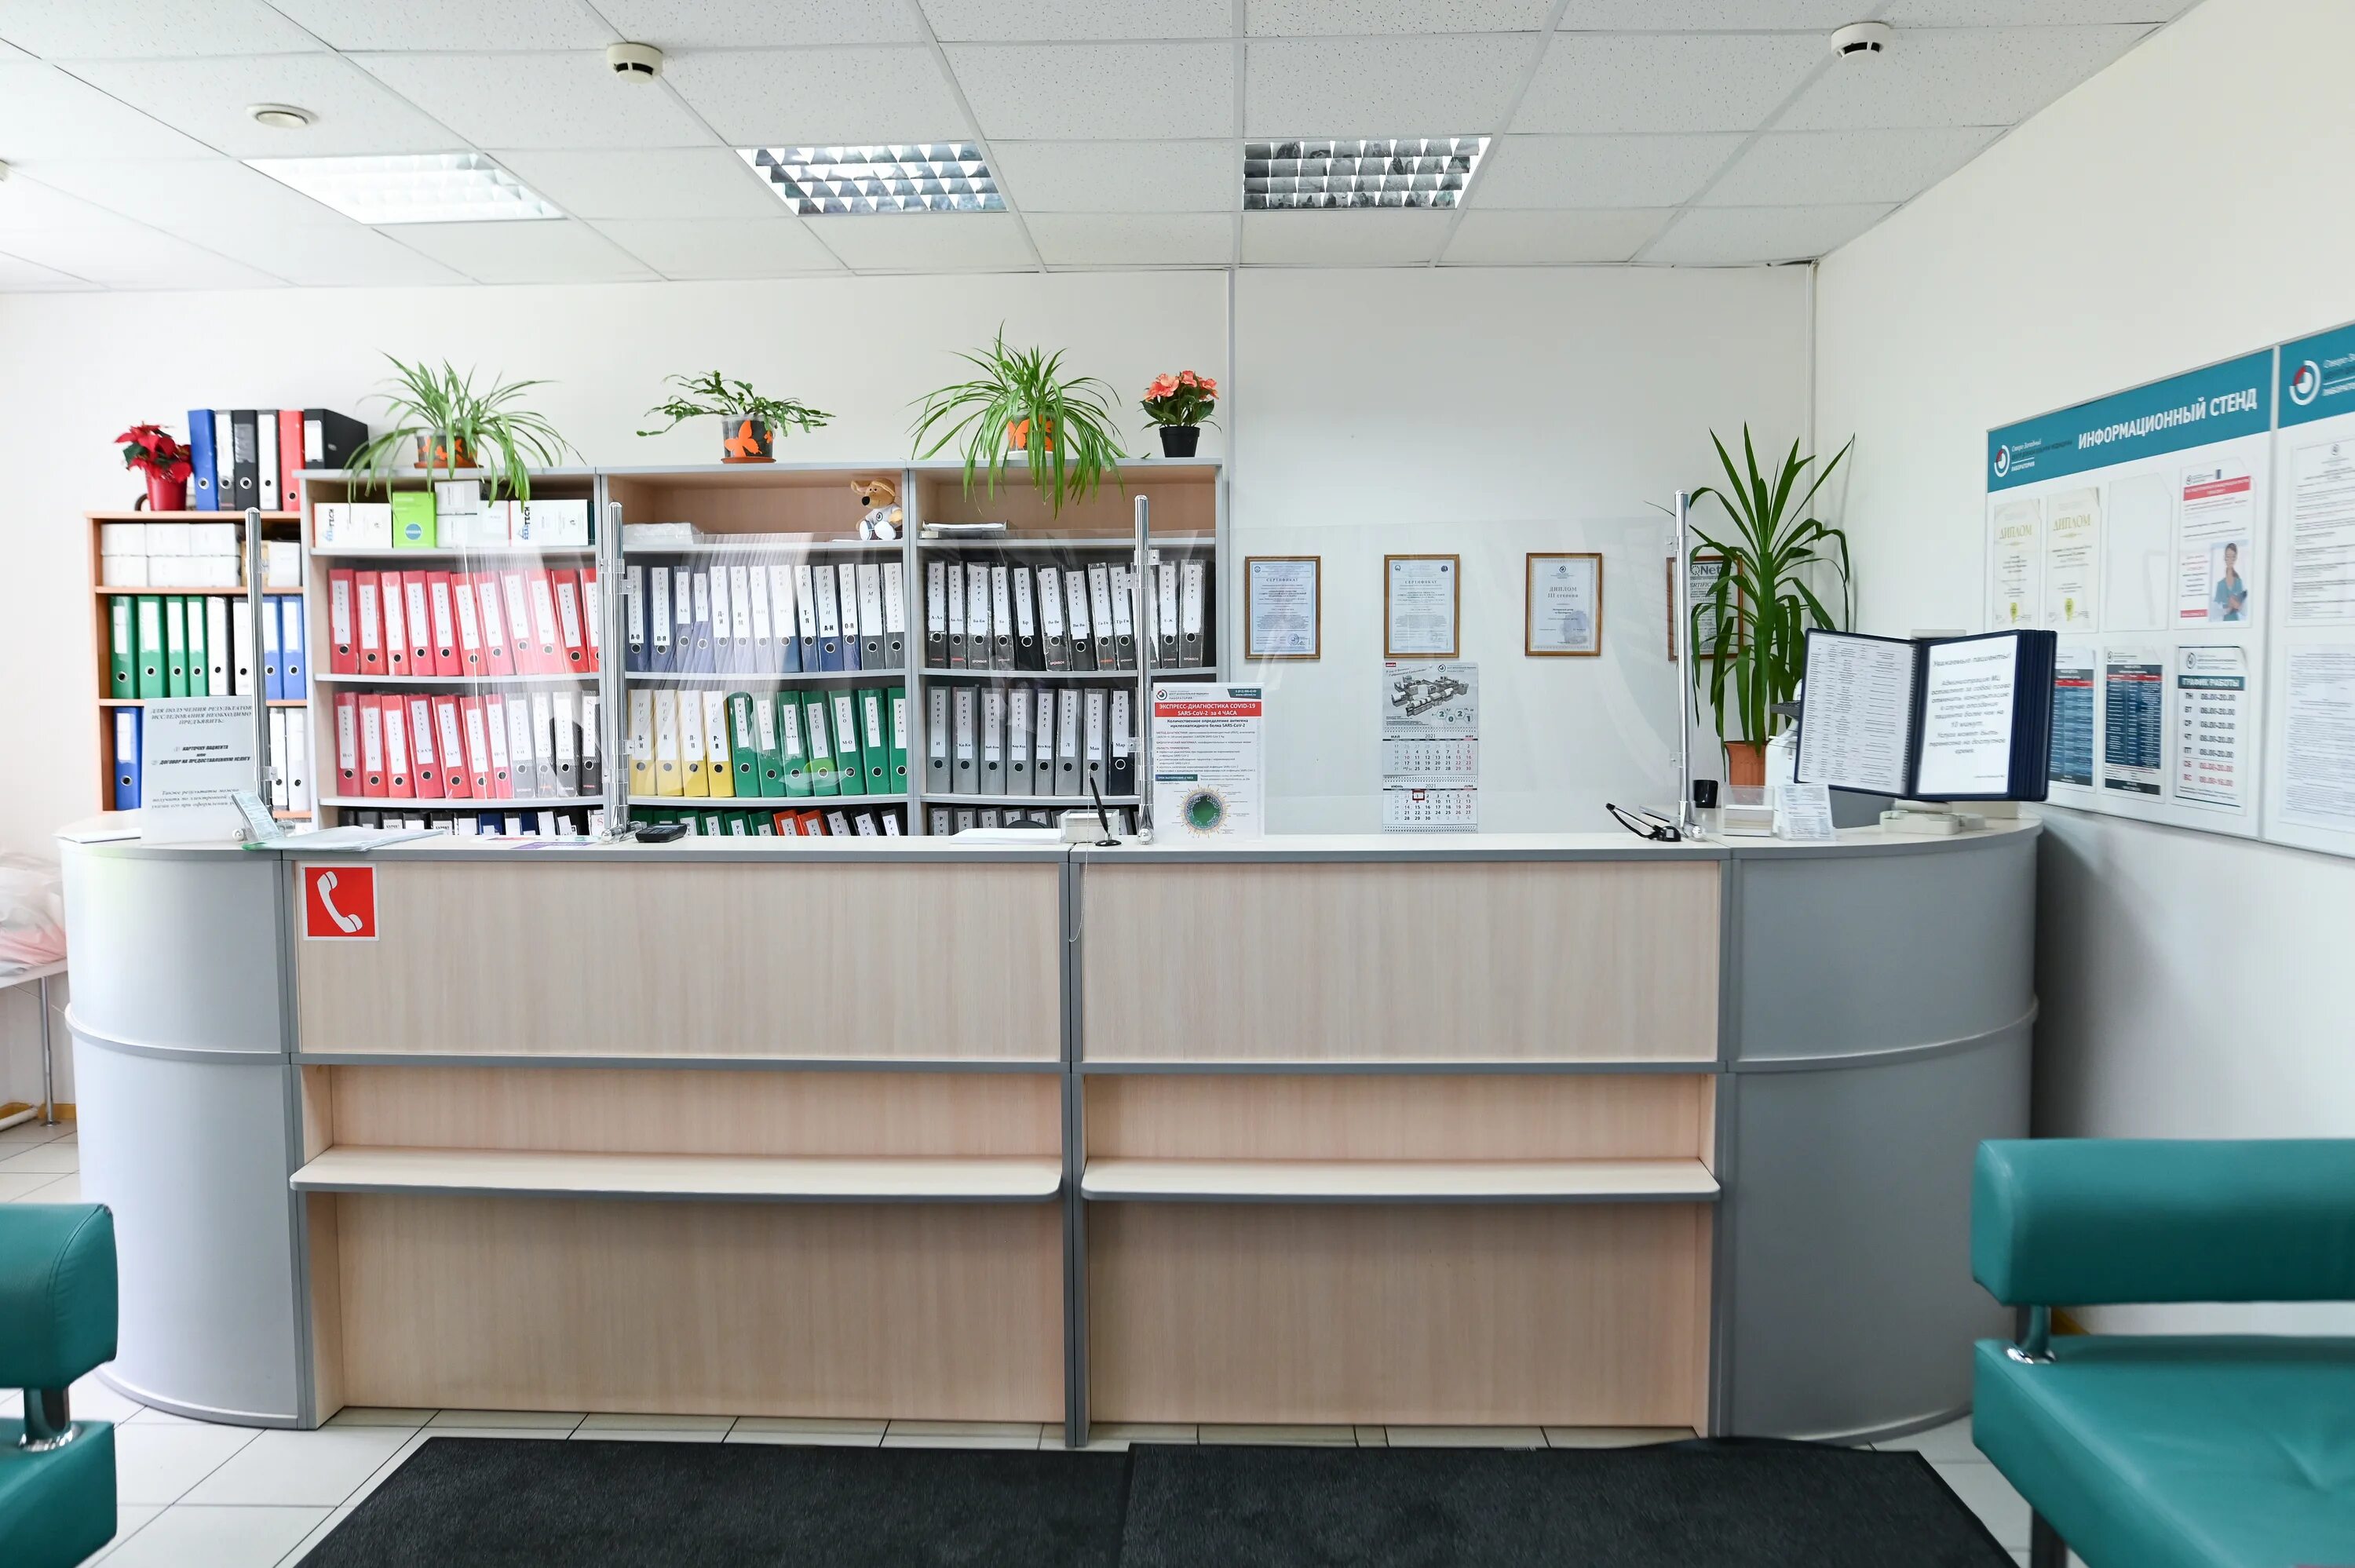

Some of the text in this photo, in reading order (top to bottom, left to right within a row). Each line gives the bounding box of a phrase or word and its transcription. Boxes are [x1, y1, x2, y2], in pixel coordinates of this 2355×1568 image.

[2079, 388, 2257, 450] ИНФОРМАЦИОННЫЙ СТЕНД
[2054, 514, 2090, 531] ДИПЛОМ
[1999, 524, 2032, 539] ДИПЛОМ
